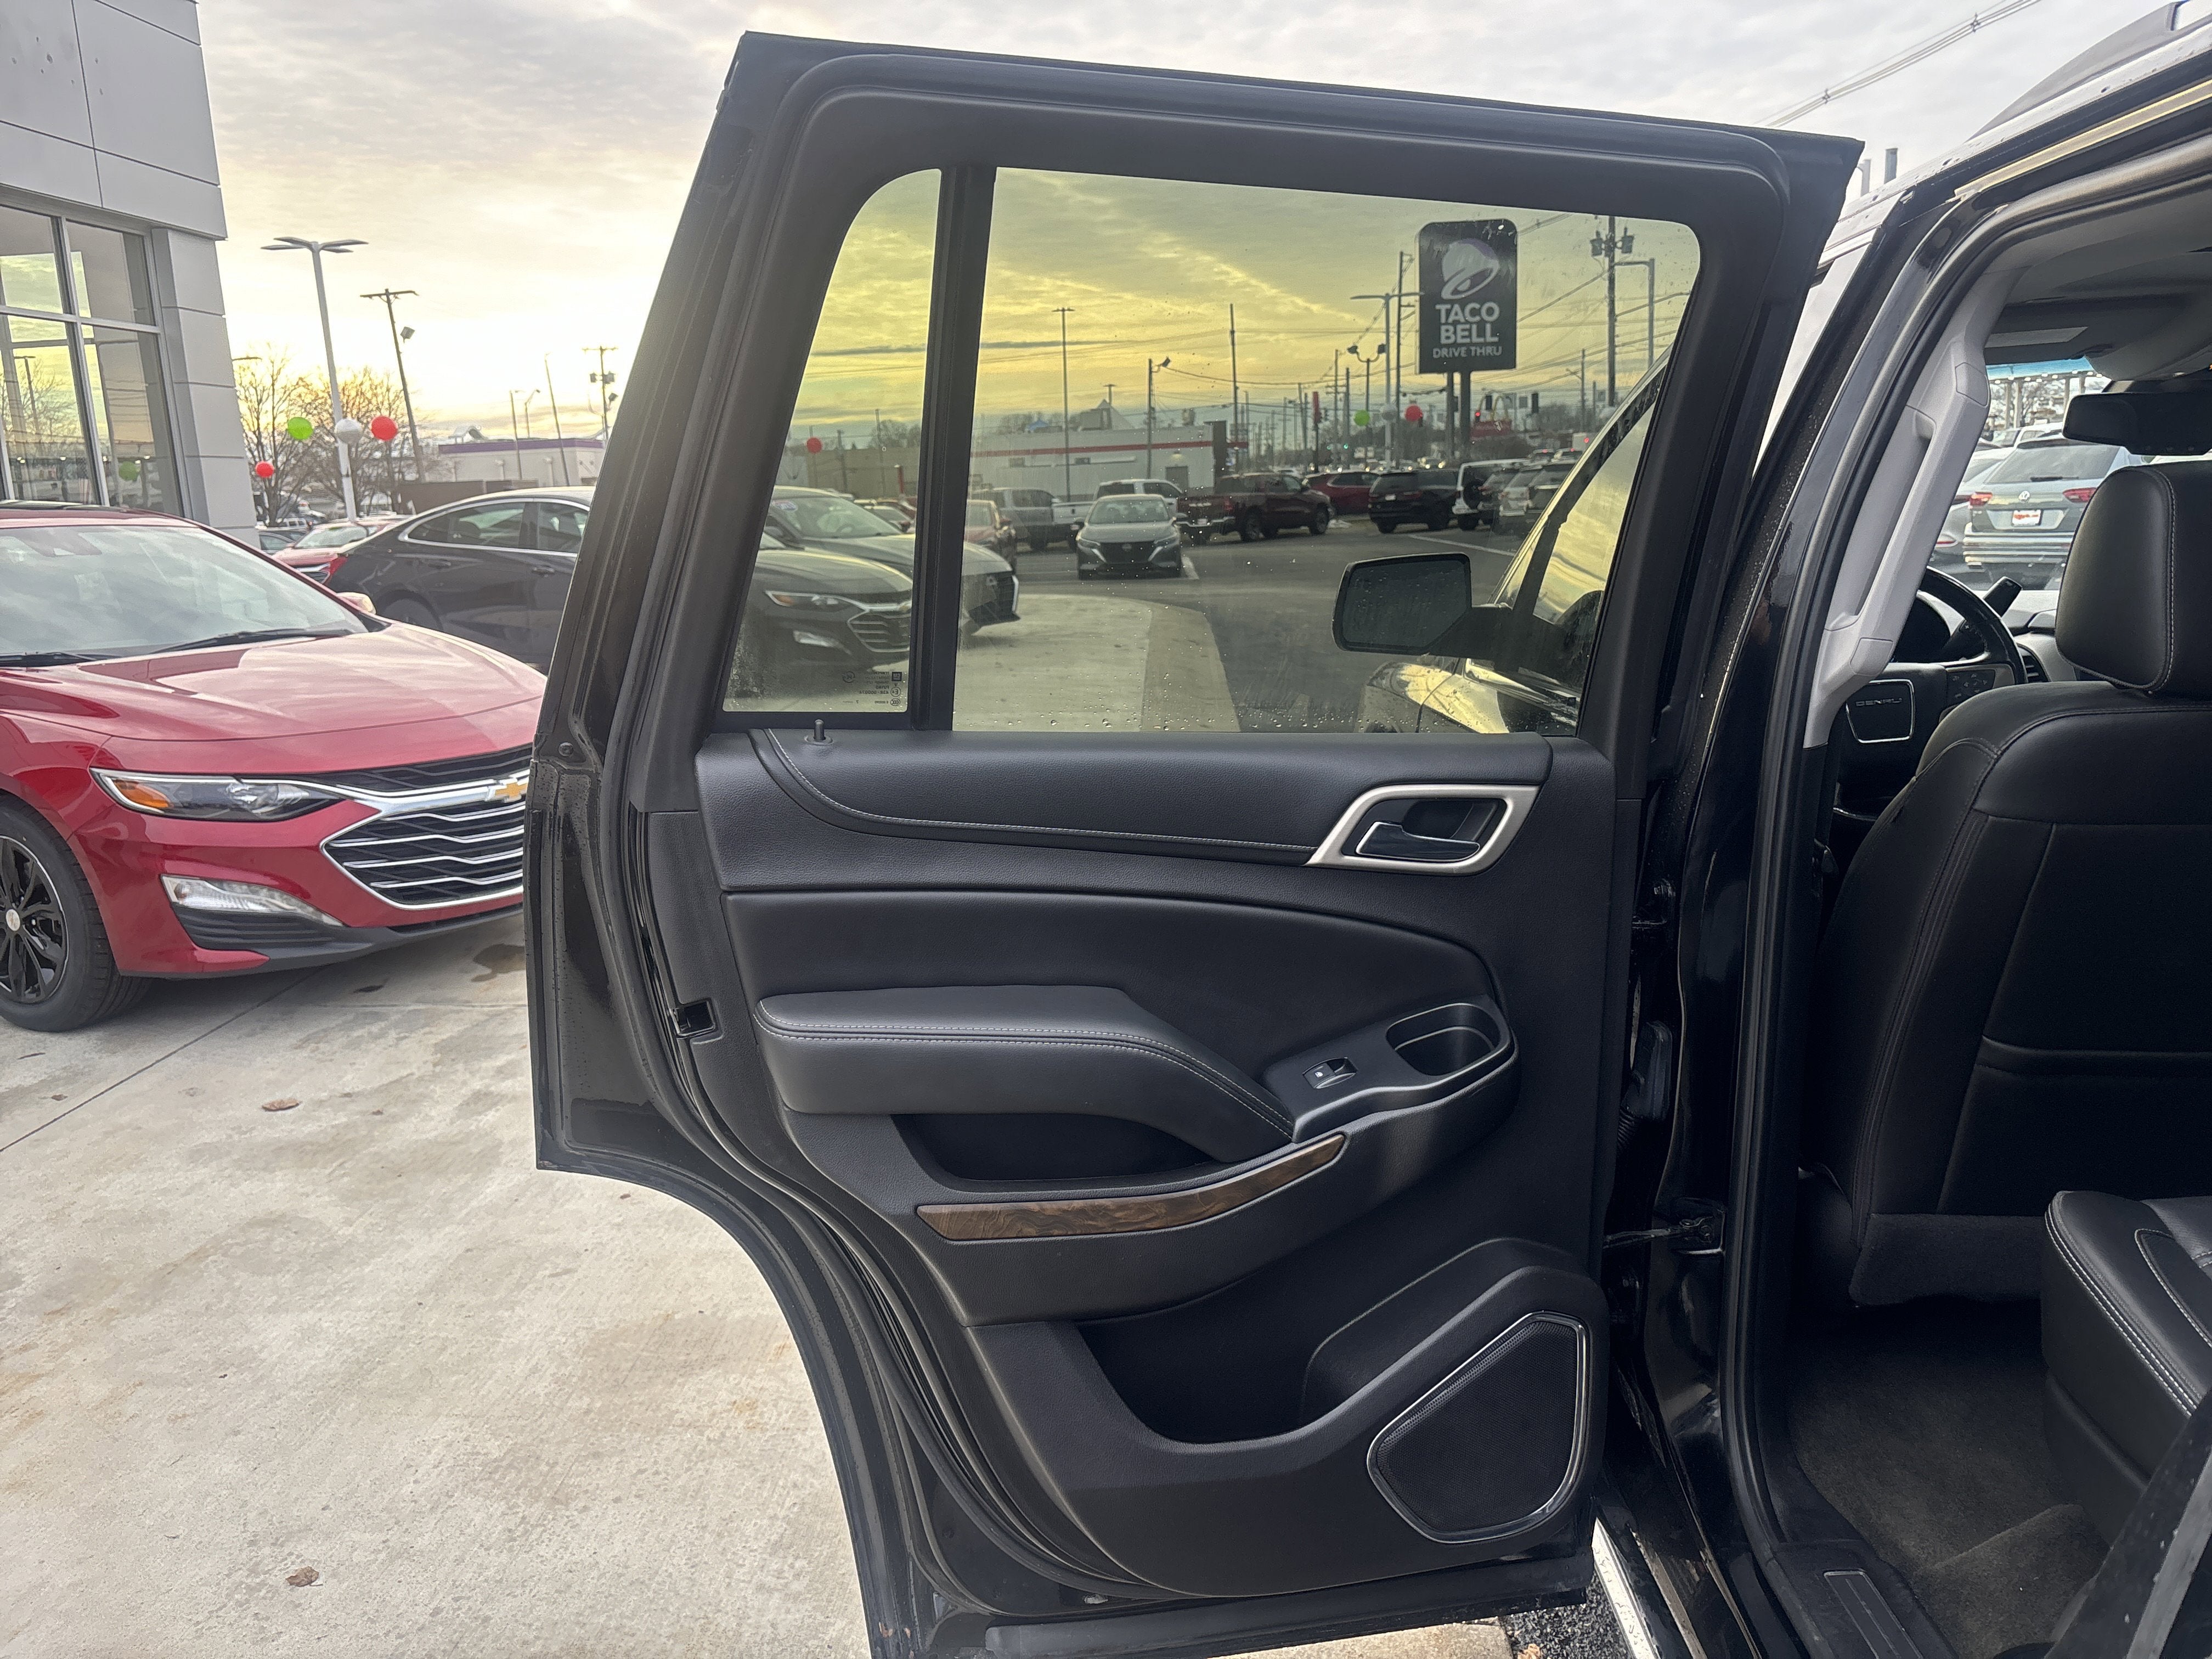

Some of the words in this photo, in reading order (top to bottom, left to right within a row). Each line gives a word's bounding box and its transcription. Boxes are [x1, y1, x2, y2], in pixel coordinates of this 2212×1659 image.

[1435, 302, 1500, 323] TACO
[1440, 323, 1499, 345] BELL
[1432, 347, 1467, 358] DRIVE
[1471, 346, 1503, 356] THRU
